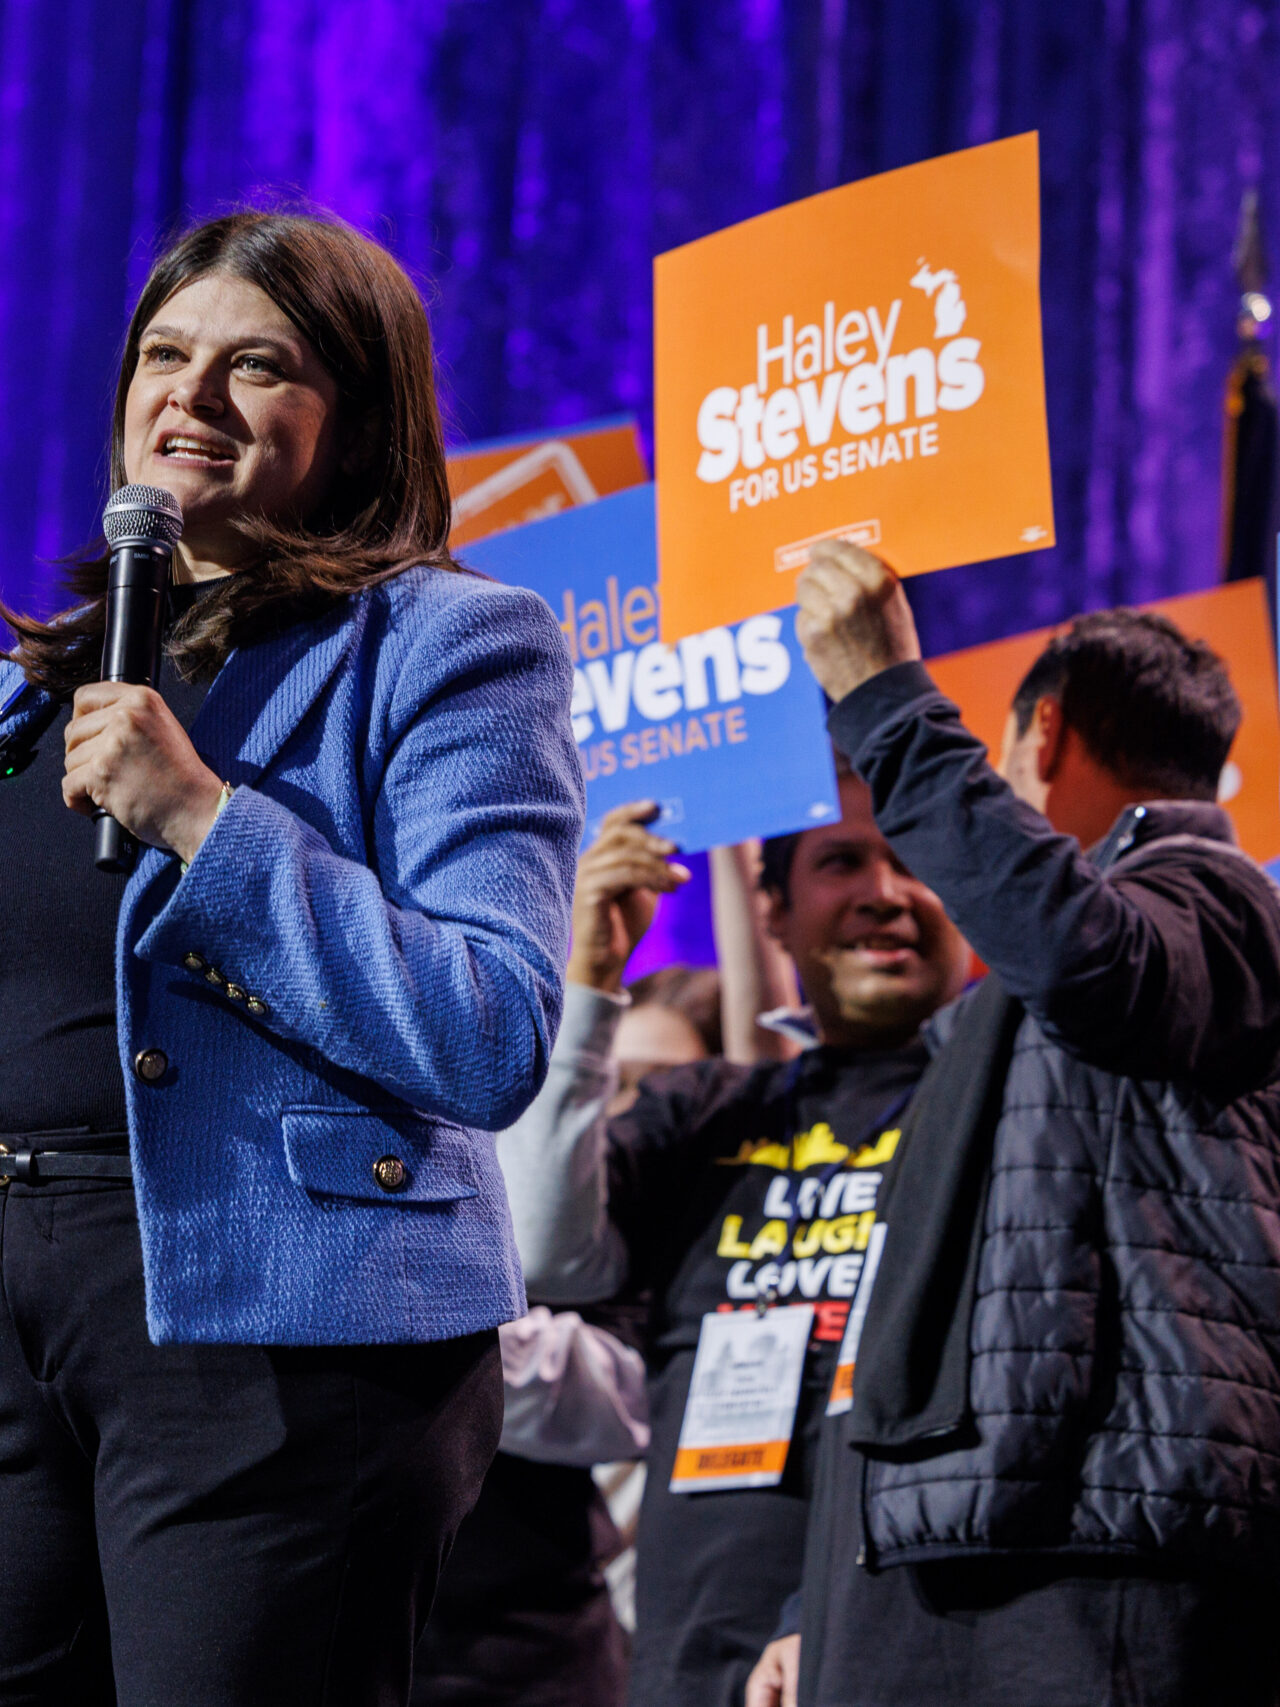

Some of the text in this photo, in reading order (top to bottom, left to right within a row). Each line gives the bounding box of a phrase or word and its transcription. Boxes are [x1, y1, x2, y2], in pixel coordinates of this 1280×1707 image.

[757, 298, 902, 395] Haley
[696, 336, 985, 483] Stevens
[729, 421, 939, 513] FOR US SENATE
[621, 706, 748, 770] SENATE
